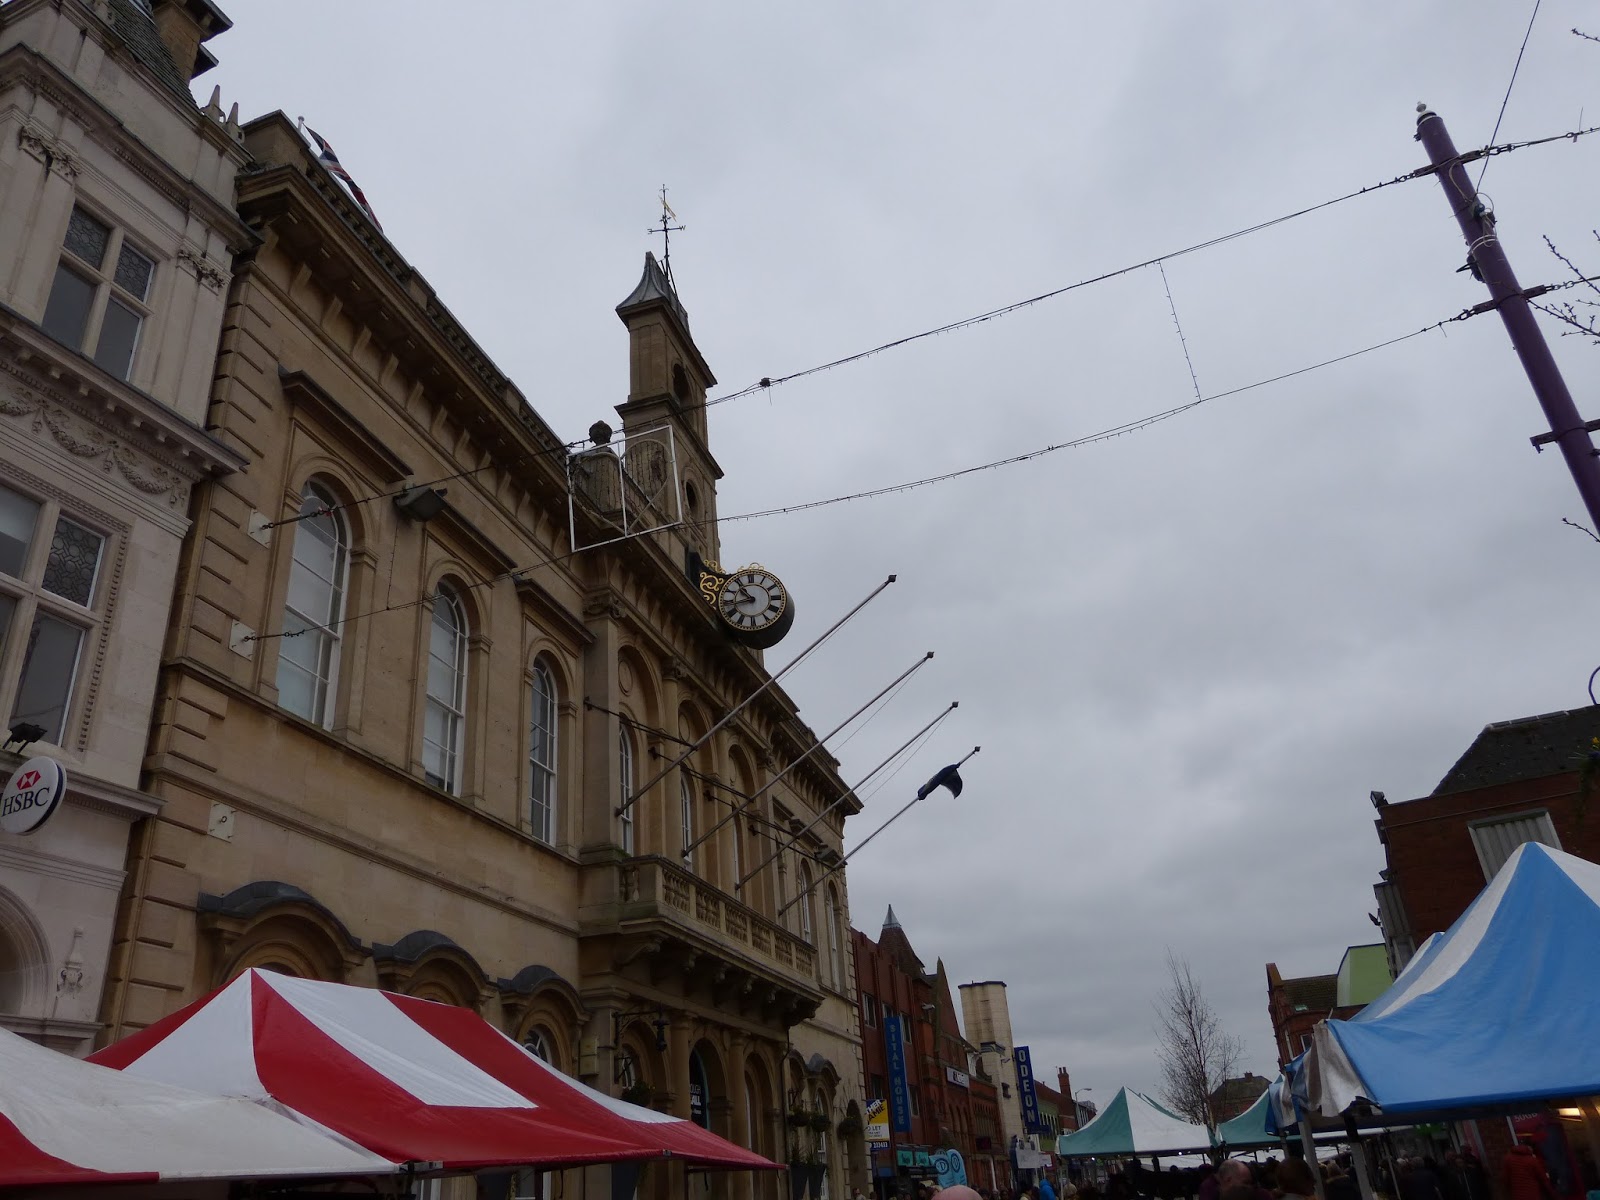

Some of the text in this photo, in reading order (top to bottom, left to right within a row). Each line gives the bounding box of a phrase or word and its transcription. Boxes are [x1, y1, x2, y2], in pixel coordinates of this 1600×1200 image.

[1, 788, 50, 817] HSBC
[690, 1094, 702, 1106] ALL
[893, 1076, 905, 1125] HOUSE
[1018, 1049, 1036, 1123] ODEON
